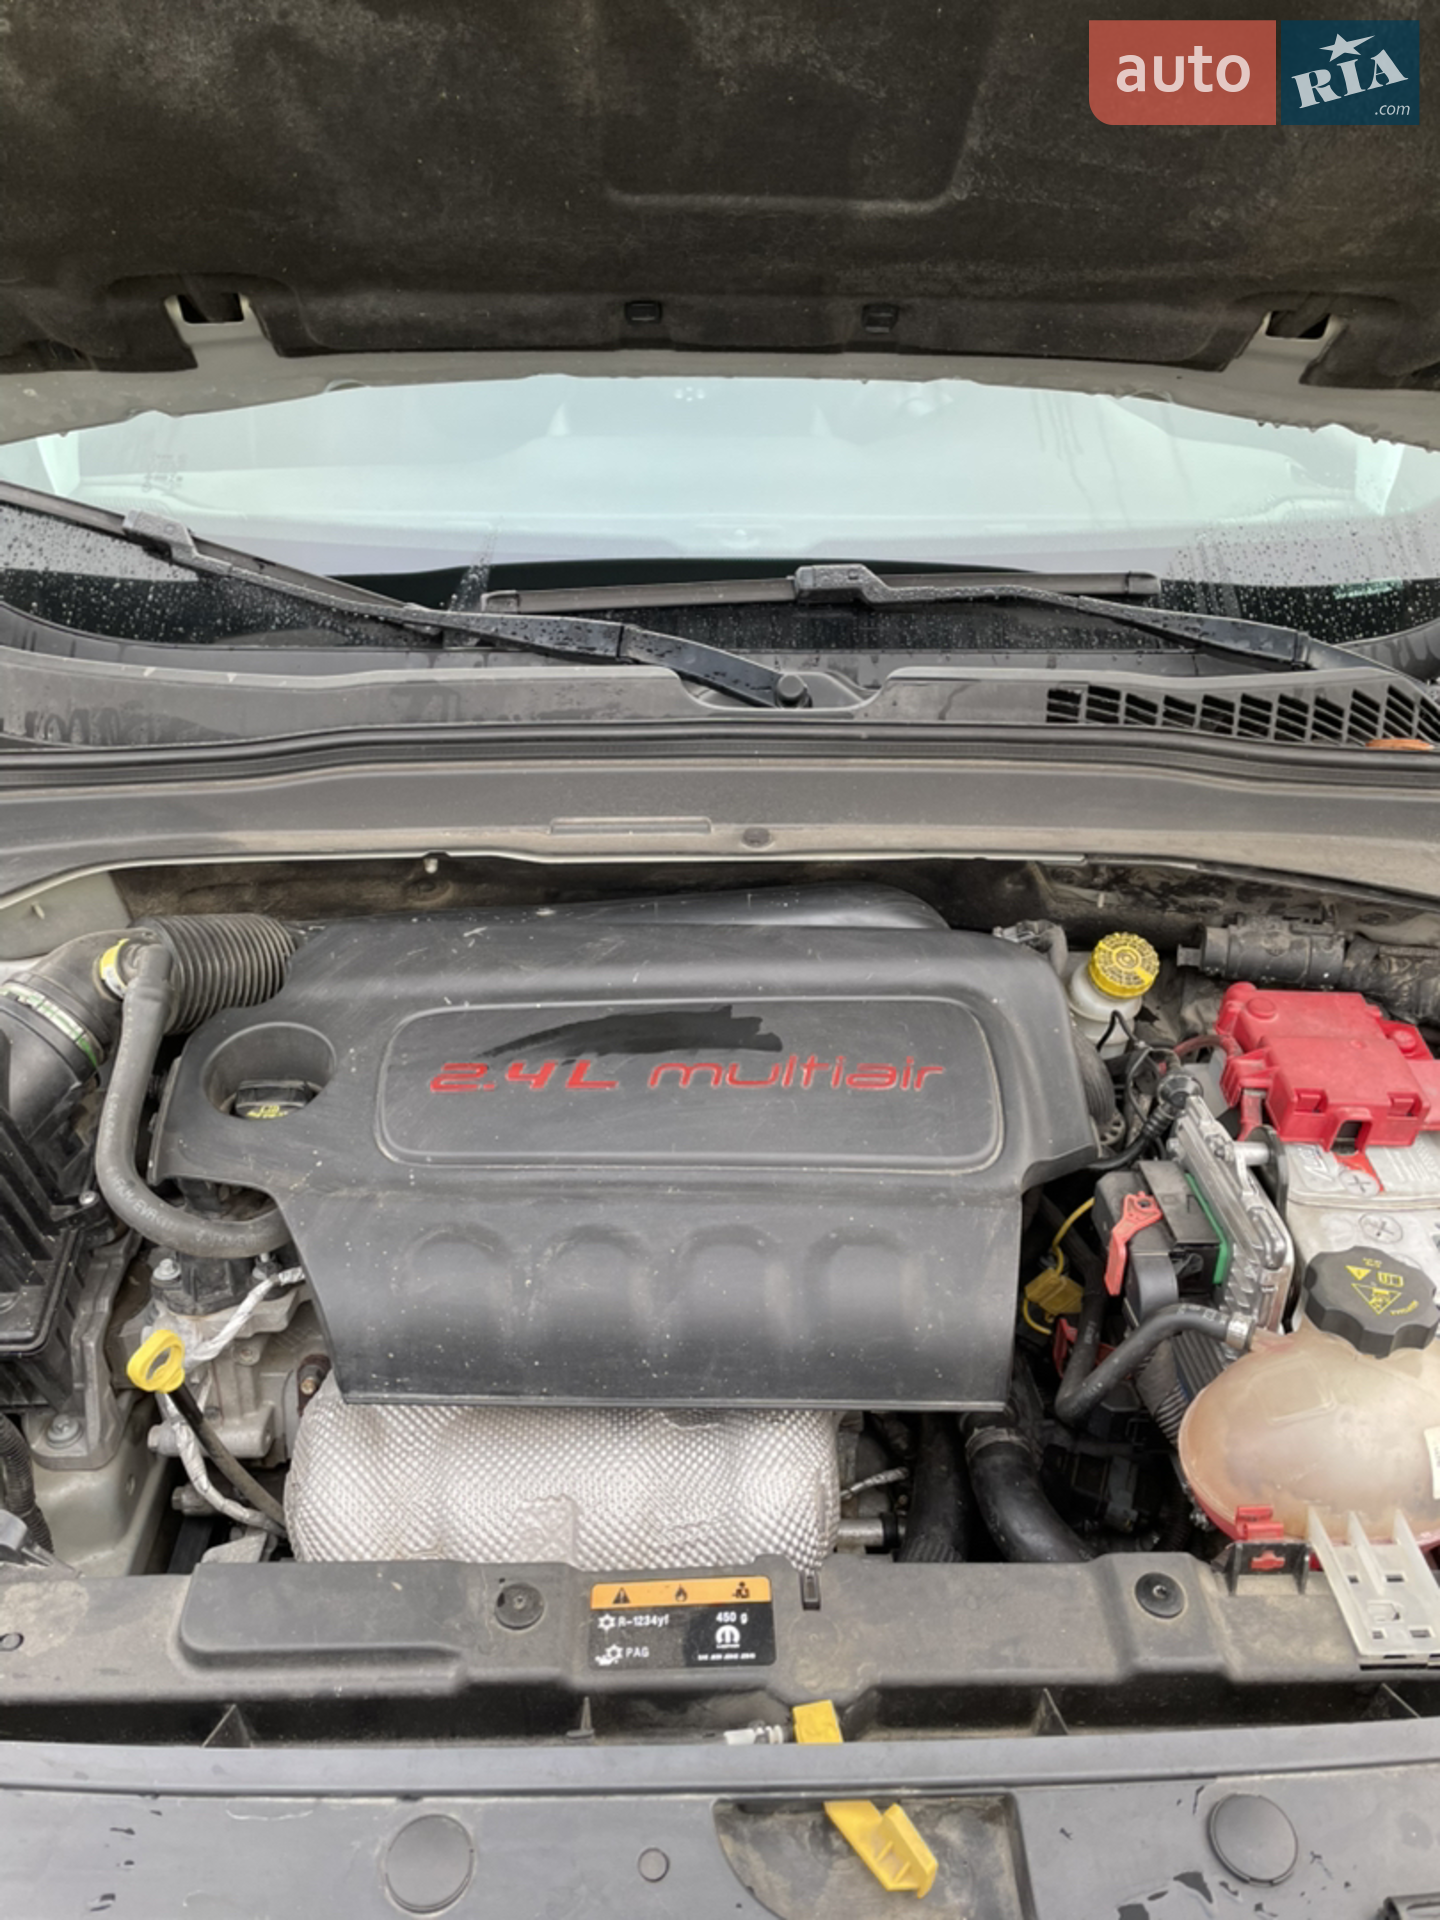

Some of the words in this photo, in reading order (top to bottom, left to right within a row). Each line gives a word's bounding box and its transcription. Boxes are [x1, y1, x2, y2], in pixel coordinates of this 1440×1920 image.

[429, 1059, 618, 1093] 2.4L
[647, 1054, 946, 1090] multiair
[617, 1613, 669, 1628] R-1234yf
[716, 1611, 736, 1623] 450
[740, 1612, 748, 1625] g
[625, 1645, 649, 1658] PAG
